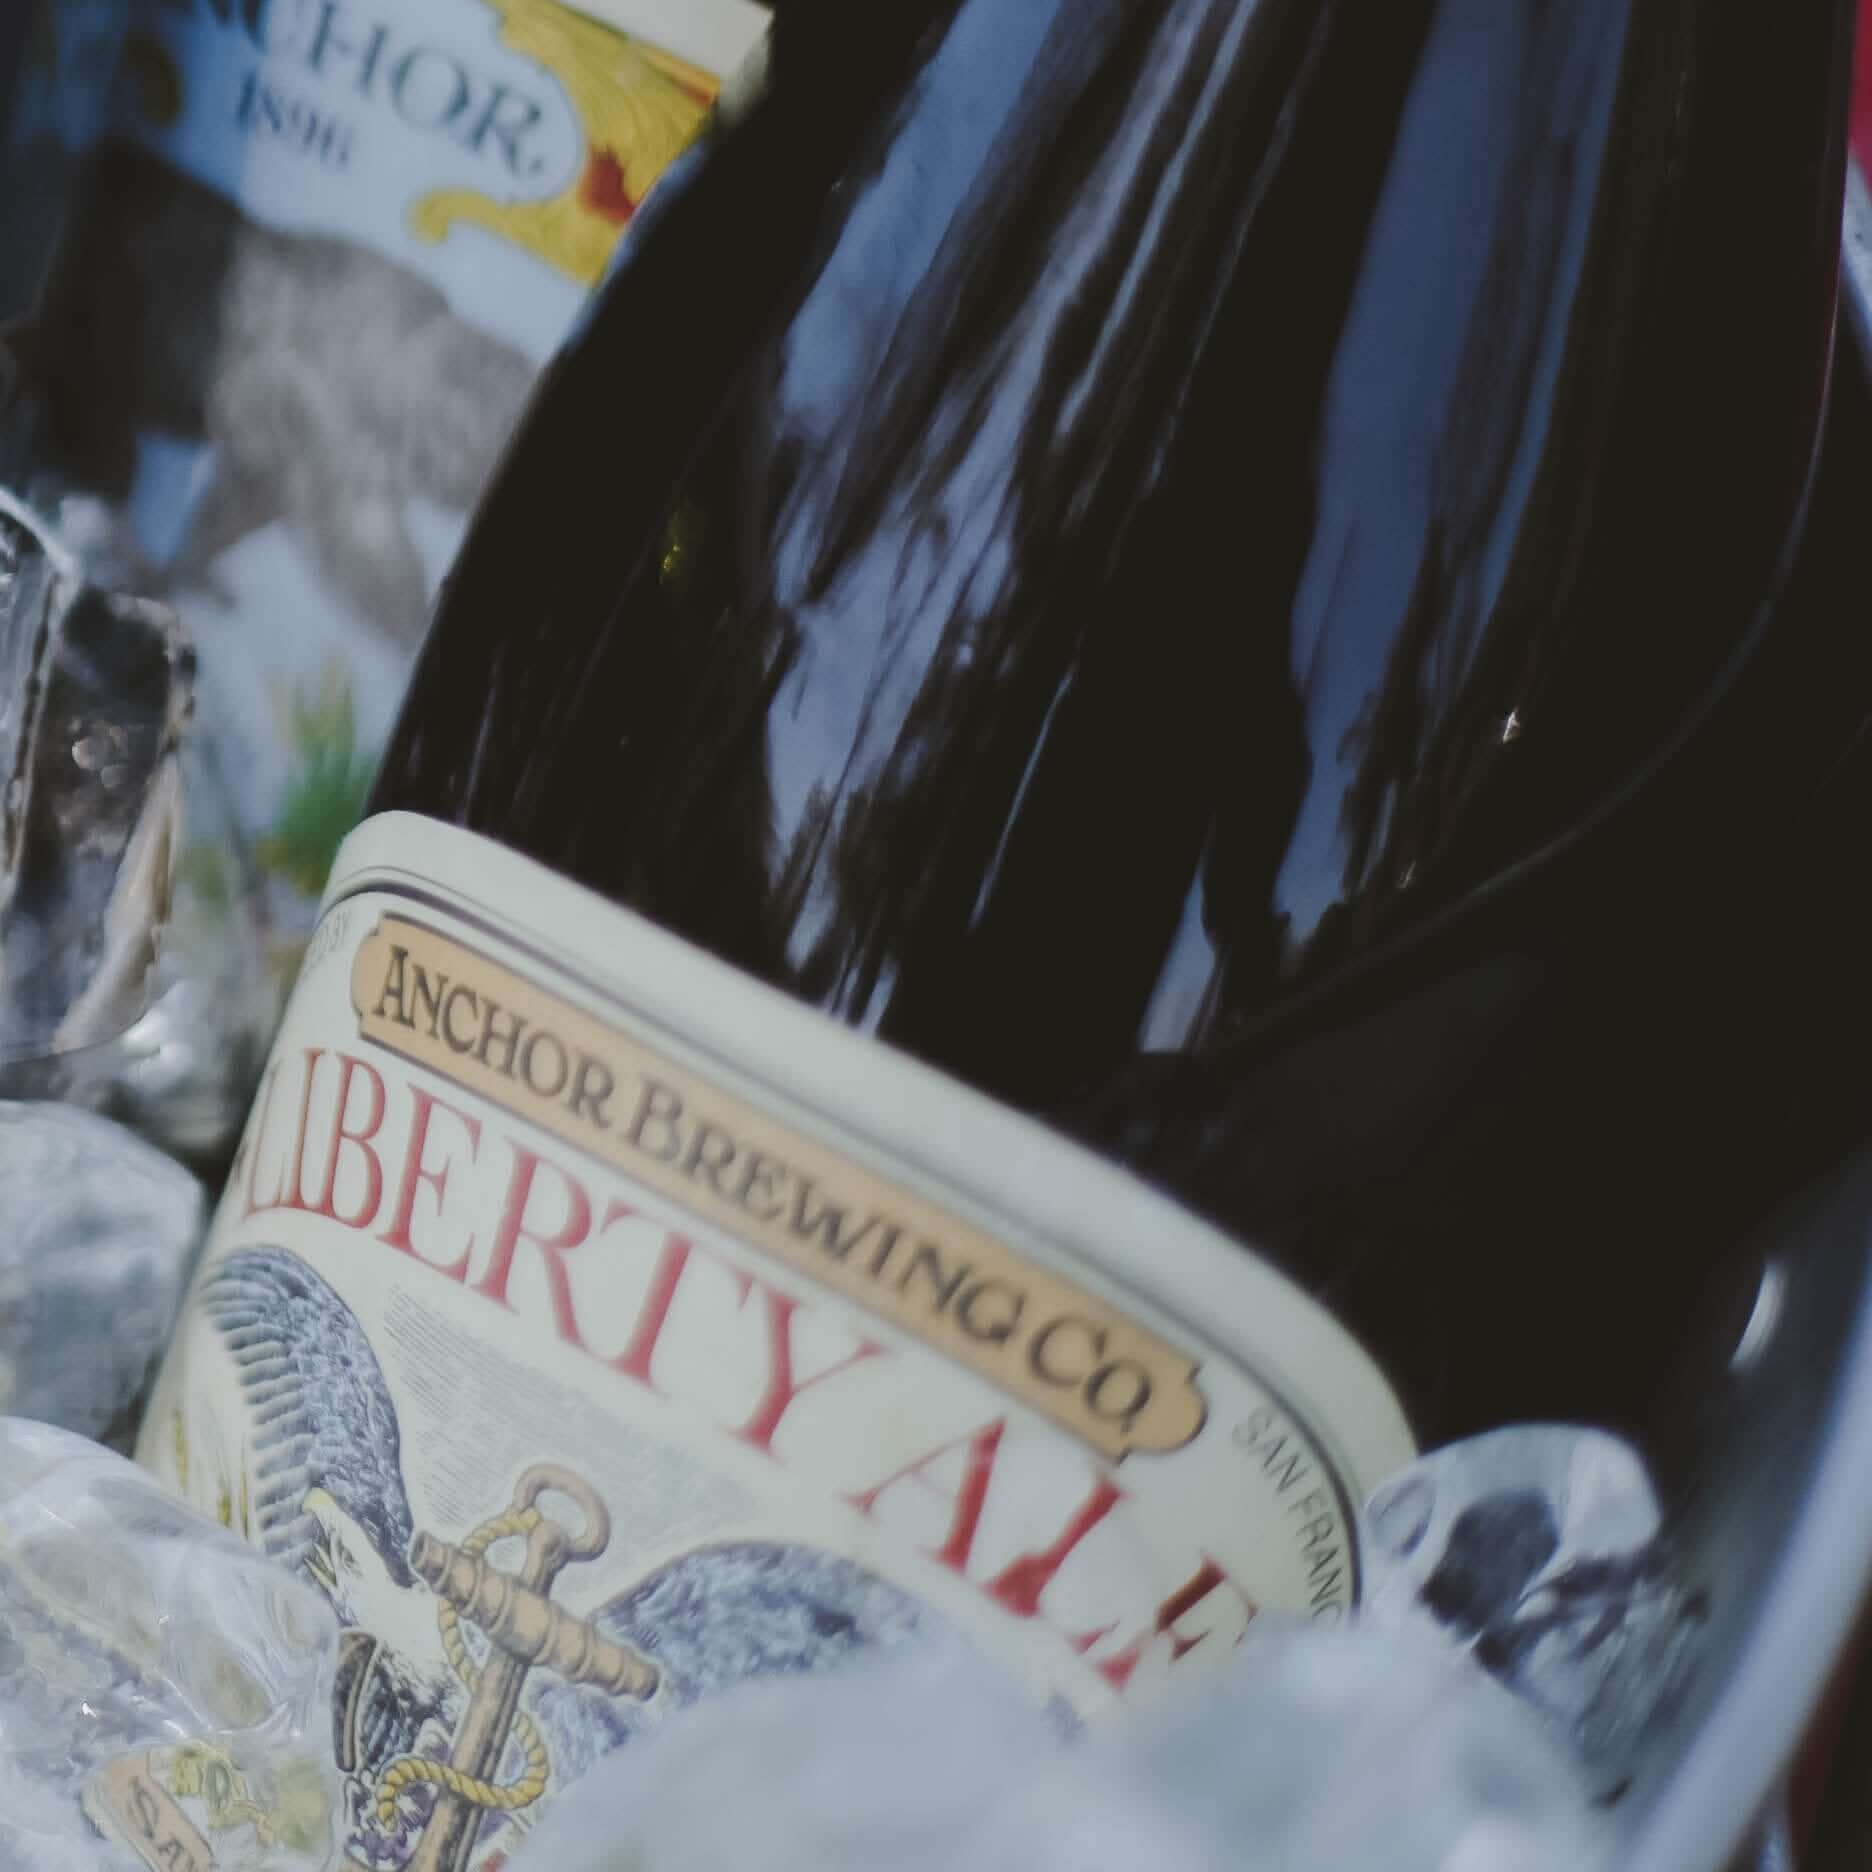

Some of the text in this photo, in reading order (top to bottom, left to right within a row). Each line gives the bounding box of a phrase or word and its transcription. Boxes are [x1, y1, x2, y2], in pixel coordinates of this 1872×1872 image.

[373, 943, 618, 1130] ANCHOR
[622, 1074, 1026, 1344] BREWING
[242, 1046, 894, 1466] LIBERTY
[838, 1415, 1259, 1694] ALE
[1232, 1406, 1309, 1495] SAN
